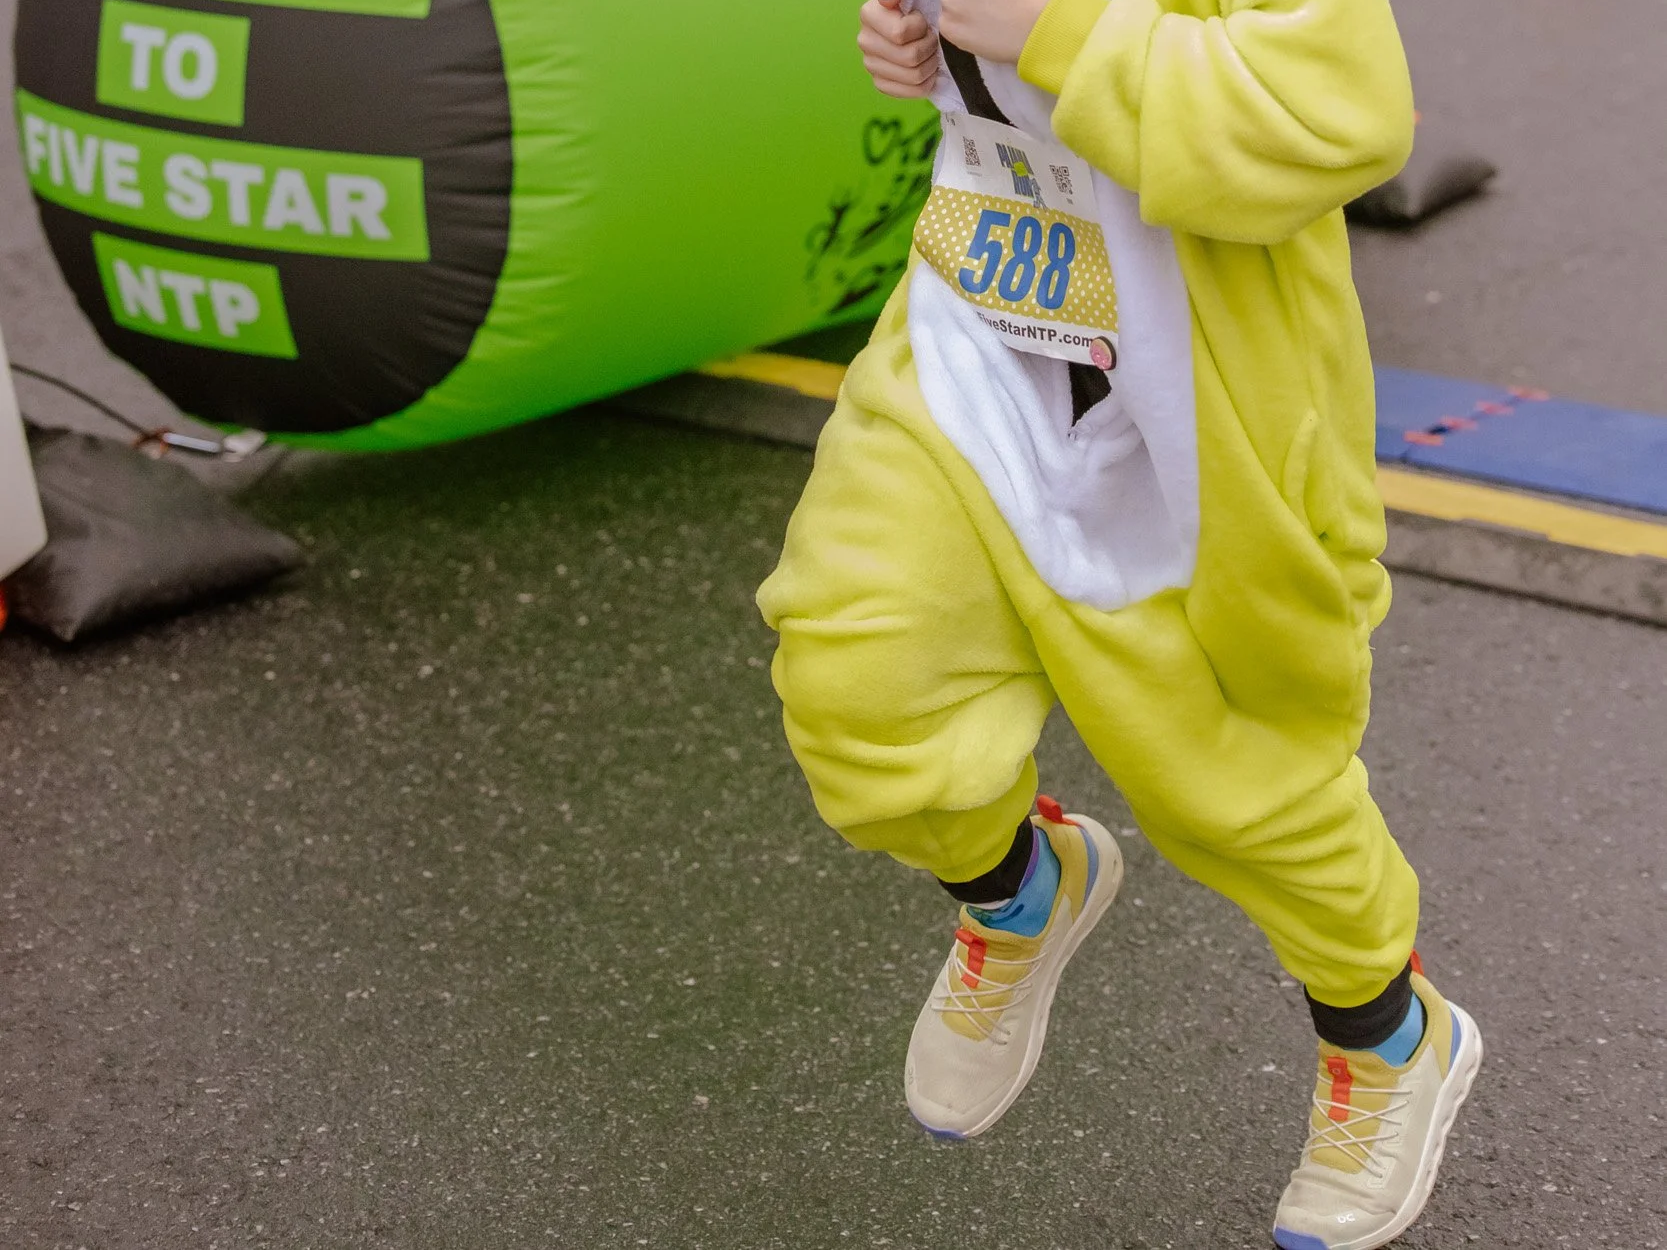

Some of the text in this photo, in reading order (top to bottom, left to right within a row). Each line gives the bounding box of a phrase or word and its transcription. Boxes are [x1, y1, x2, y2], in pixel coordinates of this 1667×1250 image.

[120, 22, 219, 100] TO
[22, 112, 392, 241] FIVE STAR
[112, 258, 260, 338] NTP
[958, 209, 1076, 310] 588
